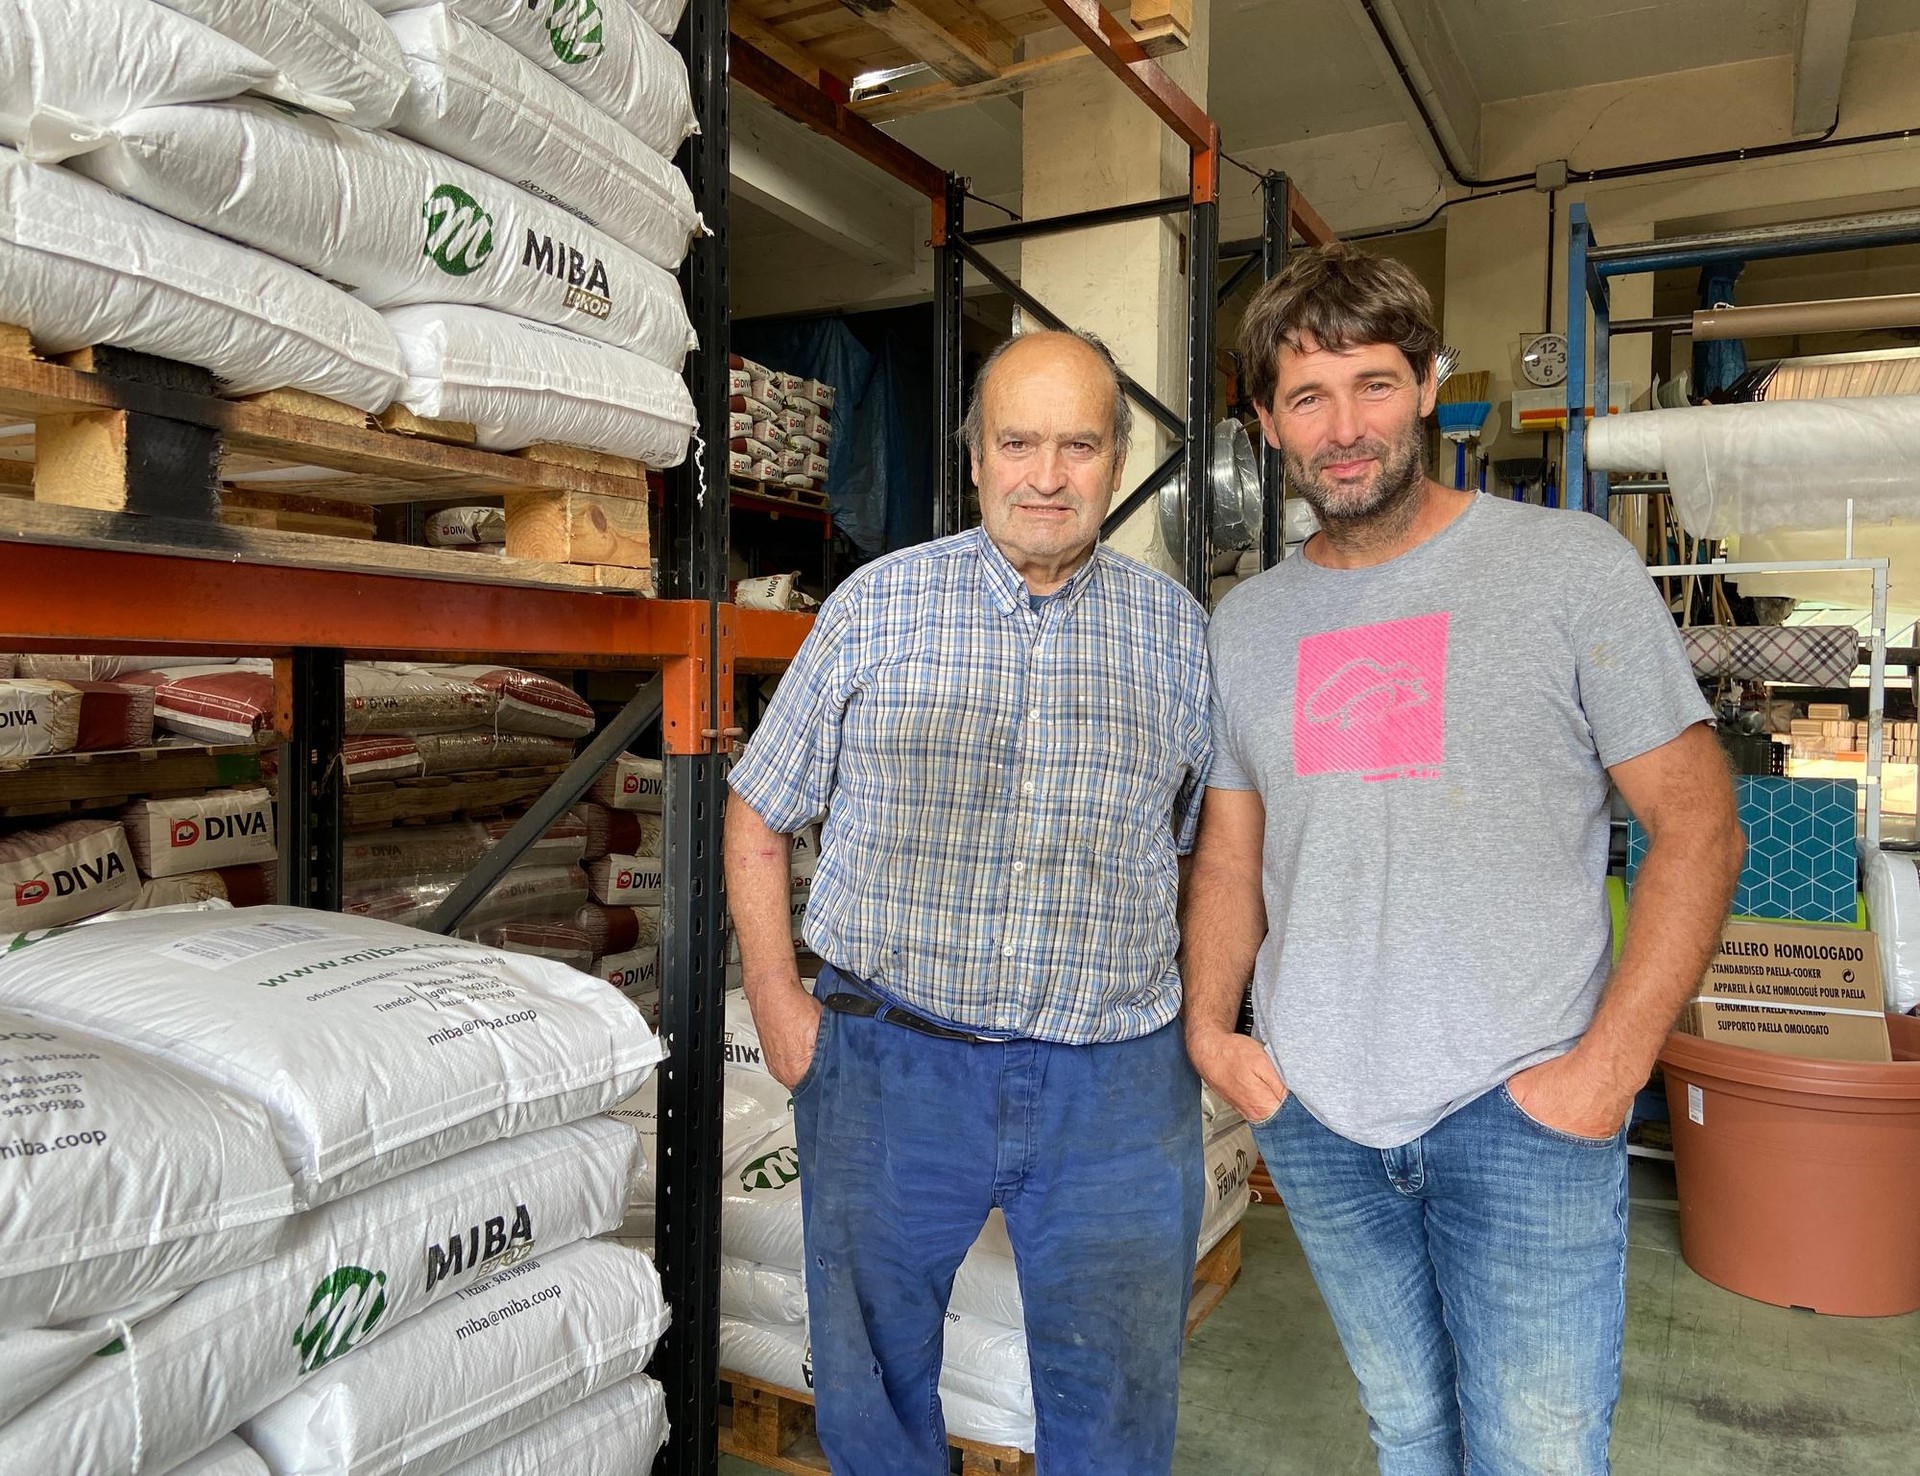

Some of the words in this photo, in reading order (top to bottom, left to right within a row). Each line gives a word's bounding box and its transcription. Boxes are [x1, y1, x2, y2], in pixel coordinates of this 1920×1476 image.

[522, 228, 610, 299] MIBA
[1540, 341, 1558, 355] 12
[1557, 352, 1566, 364] 3
[1543, 365, 1553, 377] 6
[205, 811, 267, 841] DIVA
[52, 851, 125, 897] DIVA
[1718, 941, 1769, 957] AELLERO
[1774, 943, 1864, 962] HOMOLOGADO
[624, 963, 655, 987] DIVA
[1711, 963, 1765, 977] STANDARDISED
[1765, 965, 1822, 979] PAELLA-COOKER
[306, 984, 352, 1003] Oficinas
[1713, 982, 1748, 994] APPAREIL
[1755, 984, 1772, 996] GAZ
[1772, 984, 1819, 998] HOMOLOGUÉ
[1819, 986, 1840, 999] POUR
[1840, 988, 1867, 1000] PAELLA
[373, 994, 418, 1014] Tiendas
[1717, 1020, 1756, 1032] SUPPORTO
[1757, 1022, 1783, 1034] PAELLA
[1784, 1024, 1830, 1036] OMOLOGATO
[724, 1045, 760, 1064] MIB
[426, 1203, 533, 1293] MIBA
[463, 1280, 495, 1298] Itziar:
[492, 1260, 541, 1286] 943199300
[455, 1283, 562, 1341] miba@miba.coop
